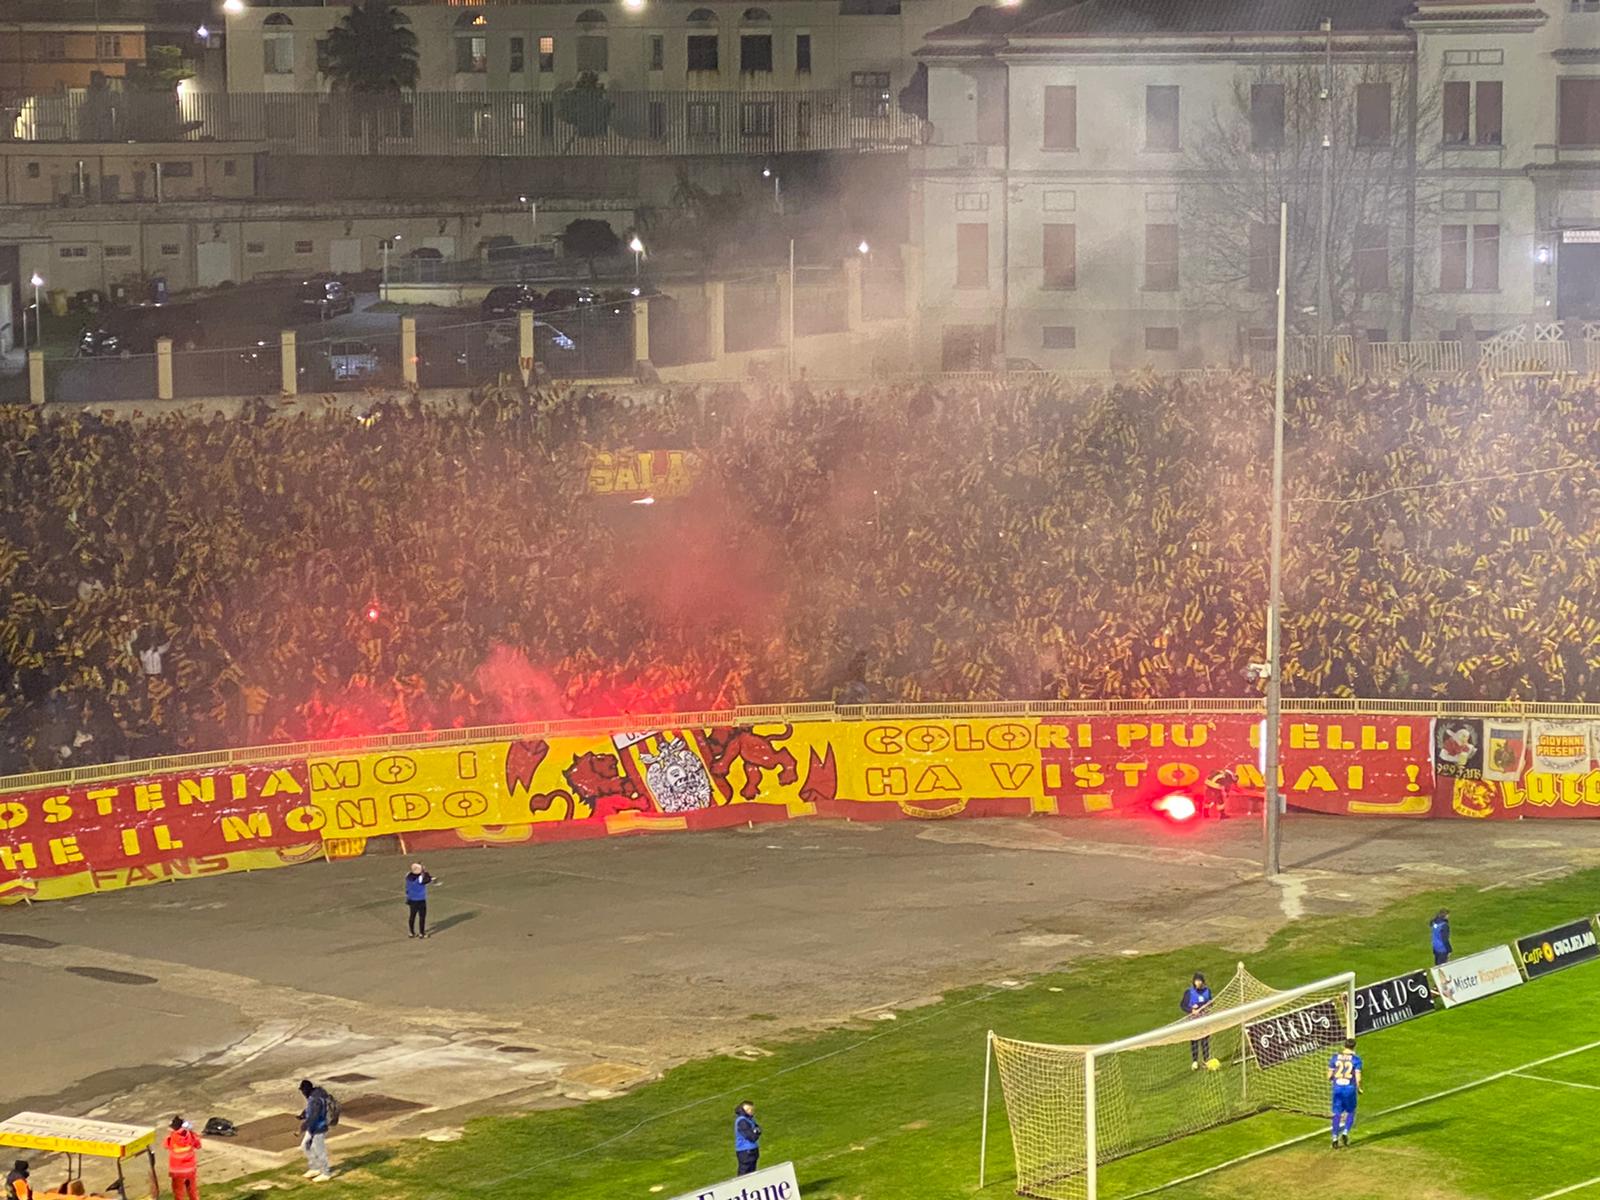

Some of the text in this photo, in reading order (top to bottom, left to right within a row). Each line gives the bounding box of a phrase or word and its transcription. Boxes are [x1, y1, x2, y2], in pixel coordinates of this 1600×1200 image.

[1539, 735, 1585, 747] GIOVANNI
[457, 751, 478, 780] I
[864, 724, 1092, 754] COLORI
[1536, 746, 1586, 758] PRESENTE
[121, 824, 183, 857] IL
[221, 790, 489, 842] MONDO
[866, 765, 962, 796] HA
[990, 762, 1200, 791] VISTO
[1453, 974, 1479, 992] Mister
[1334, 1060, 1353, 1079] 22
